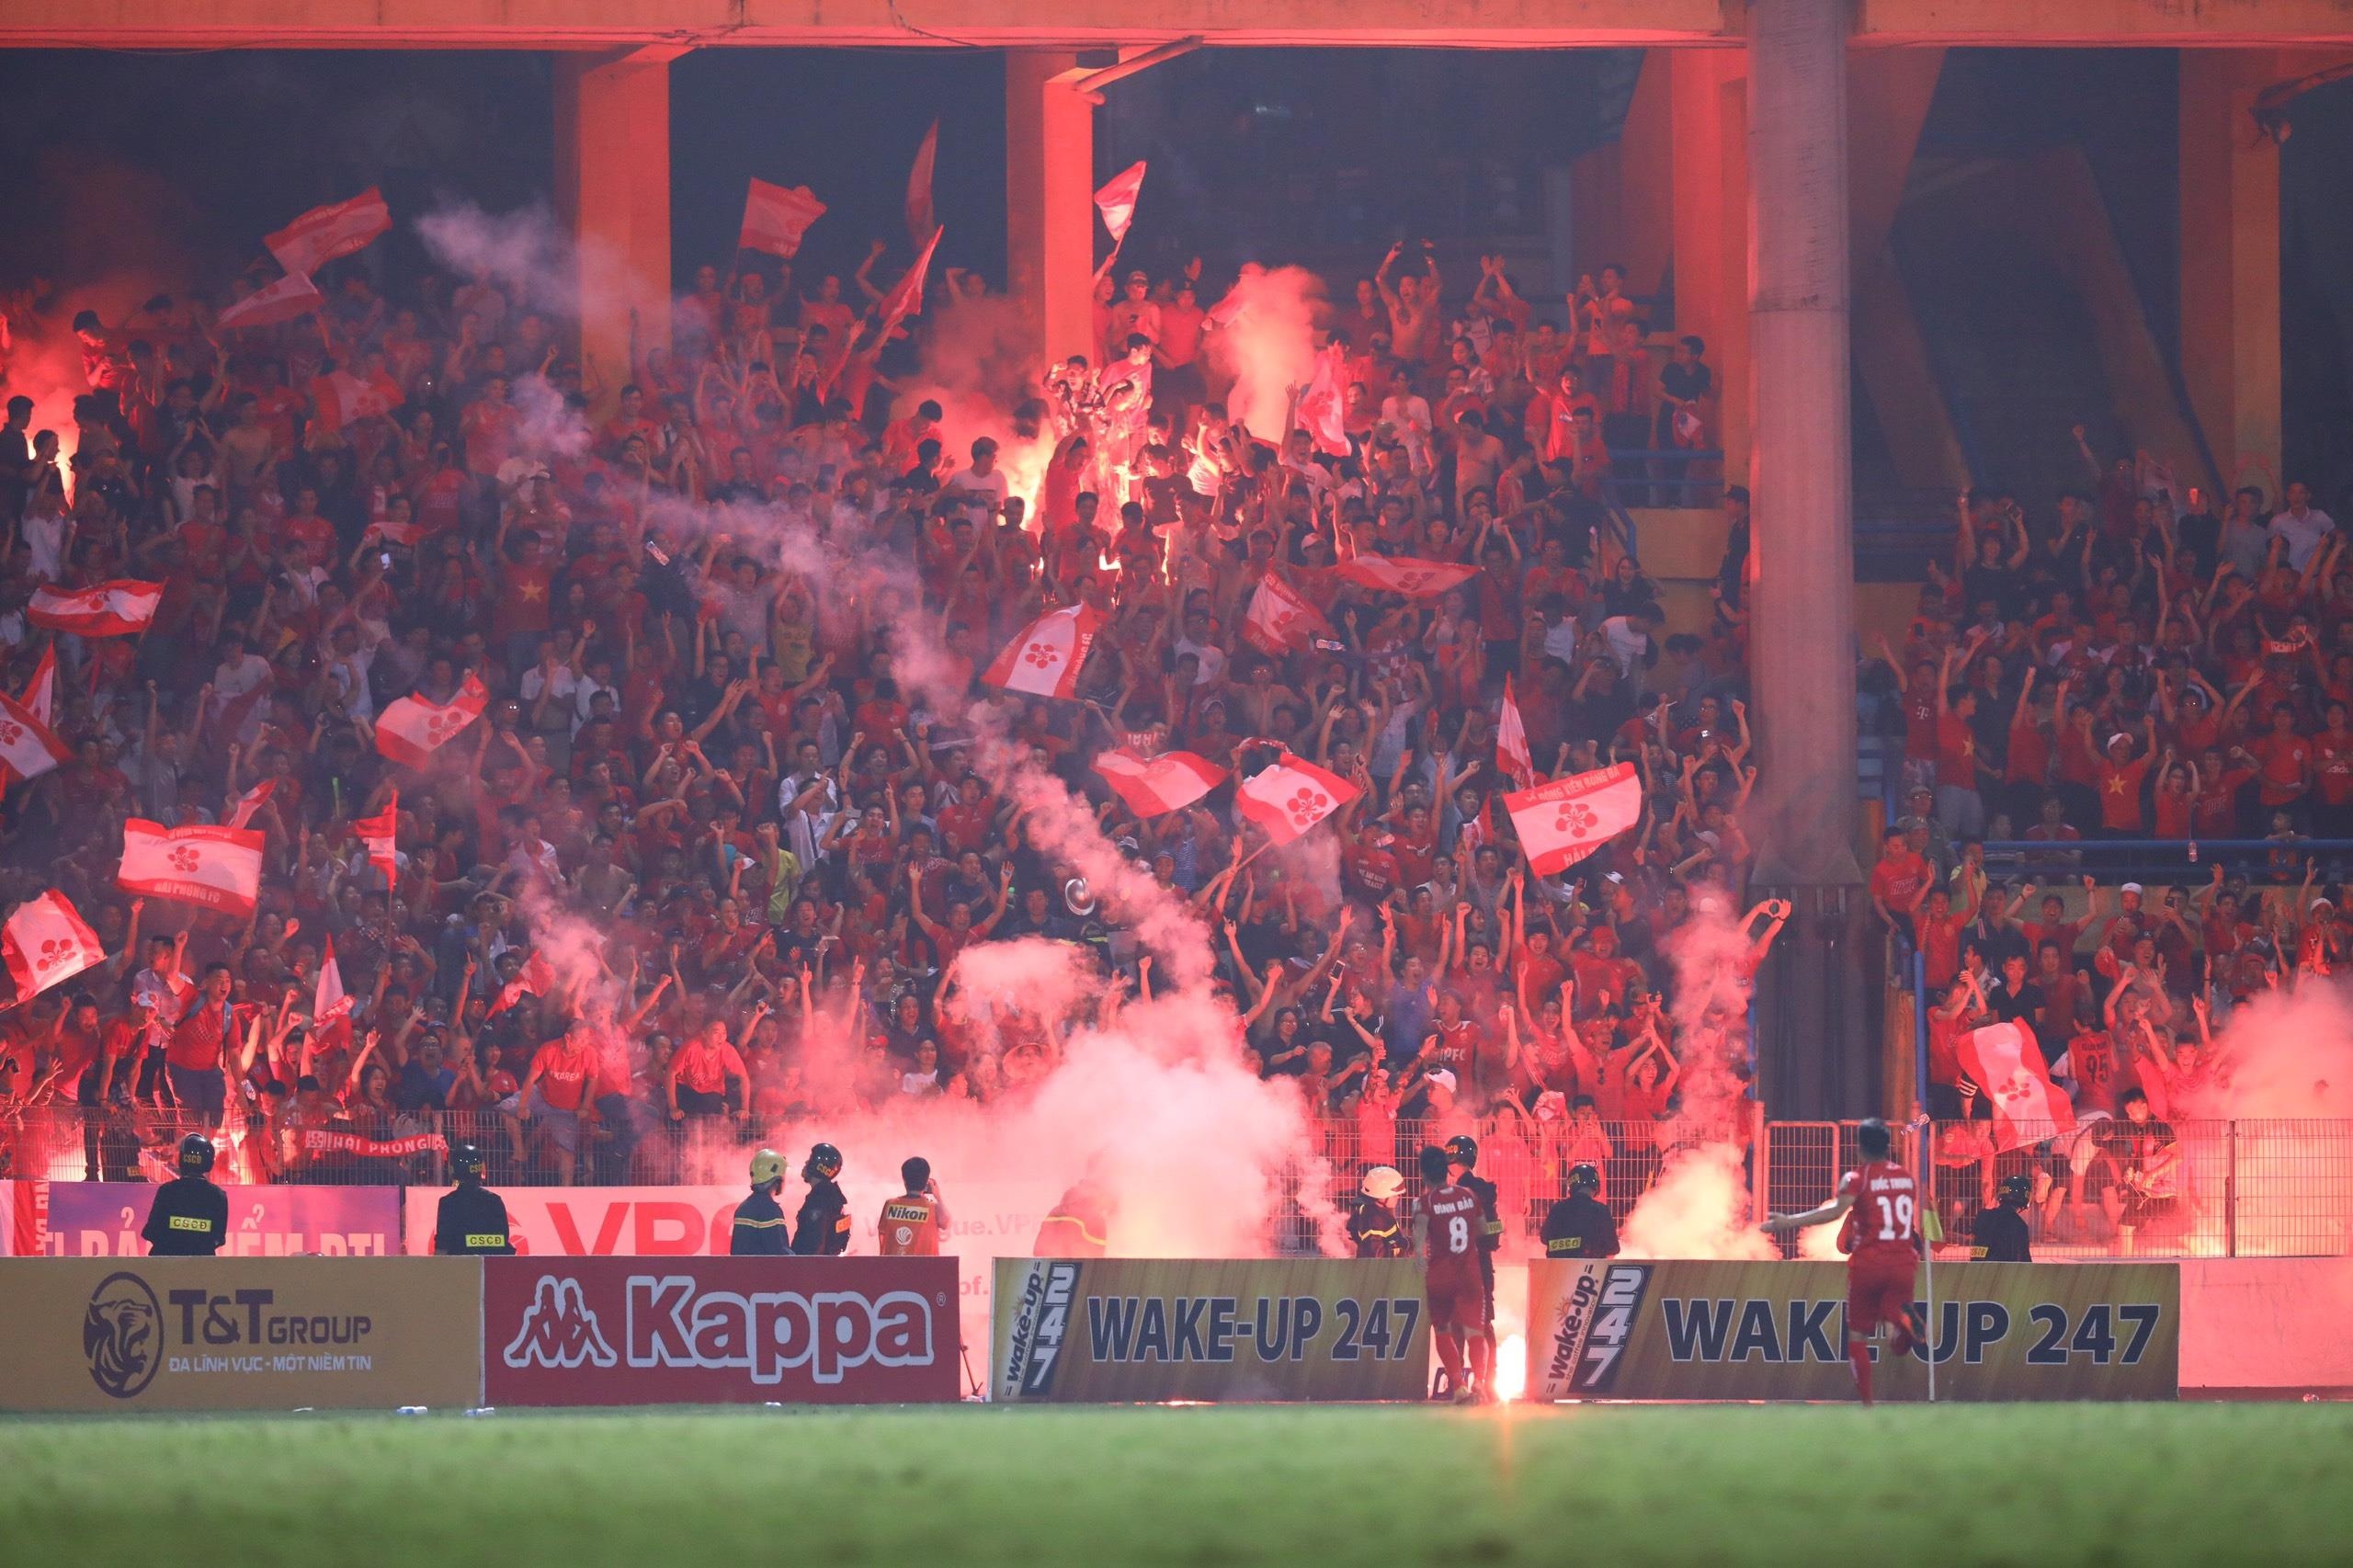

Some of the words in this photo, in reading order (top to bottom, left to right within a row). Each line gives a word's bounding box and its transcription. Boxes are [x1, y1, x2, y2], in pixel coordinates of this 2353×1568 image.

[174, 1218, 207, 1230] CSCĐ
[887, 1205, 928, 1221] Nikon
[1877, 1194, 1913, 1240] 19
[470, 1236, 502, 1245] CSCĐ
[1449, 1216, 1468, 1254] 8
[169, 1290, 273, 1345] T&T
[267, 1316, 371, 1345] GROUP
[627, 1275, 934, 1383] Kappa
[1087, 1297, 1323, 1362] WAKE-UP
[1332, 1298, 1421, 1361] 247
[2025, 1303, 2161, 1365] 247
[169, 1357, 190, 1371] ĐA
[347, 1356, 371, 1370] TIN
